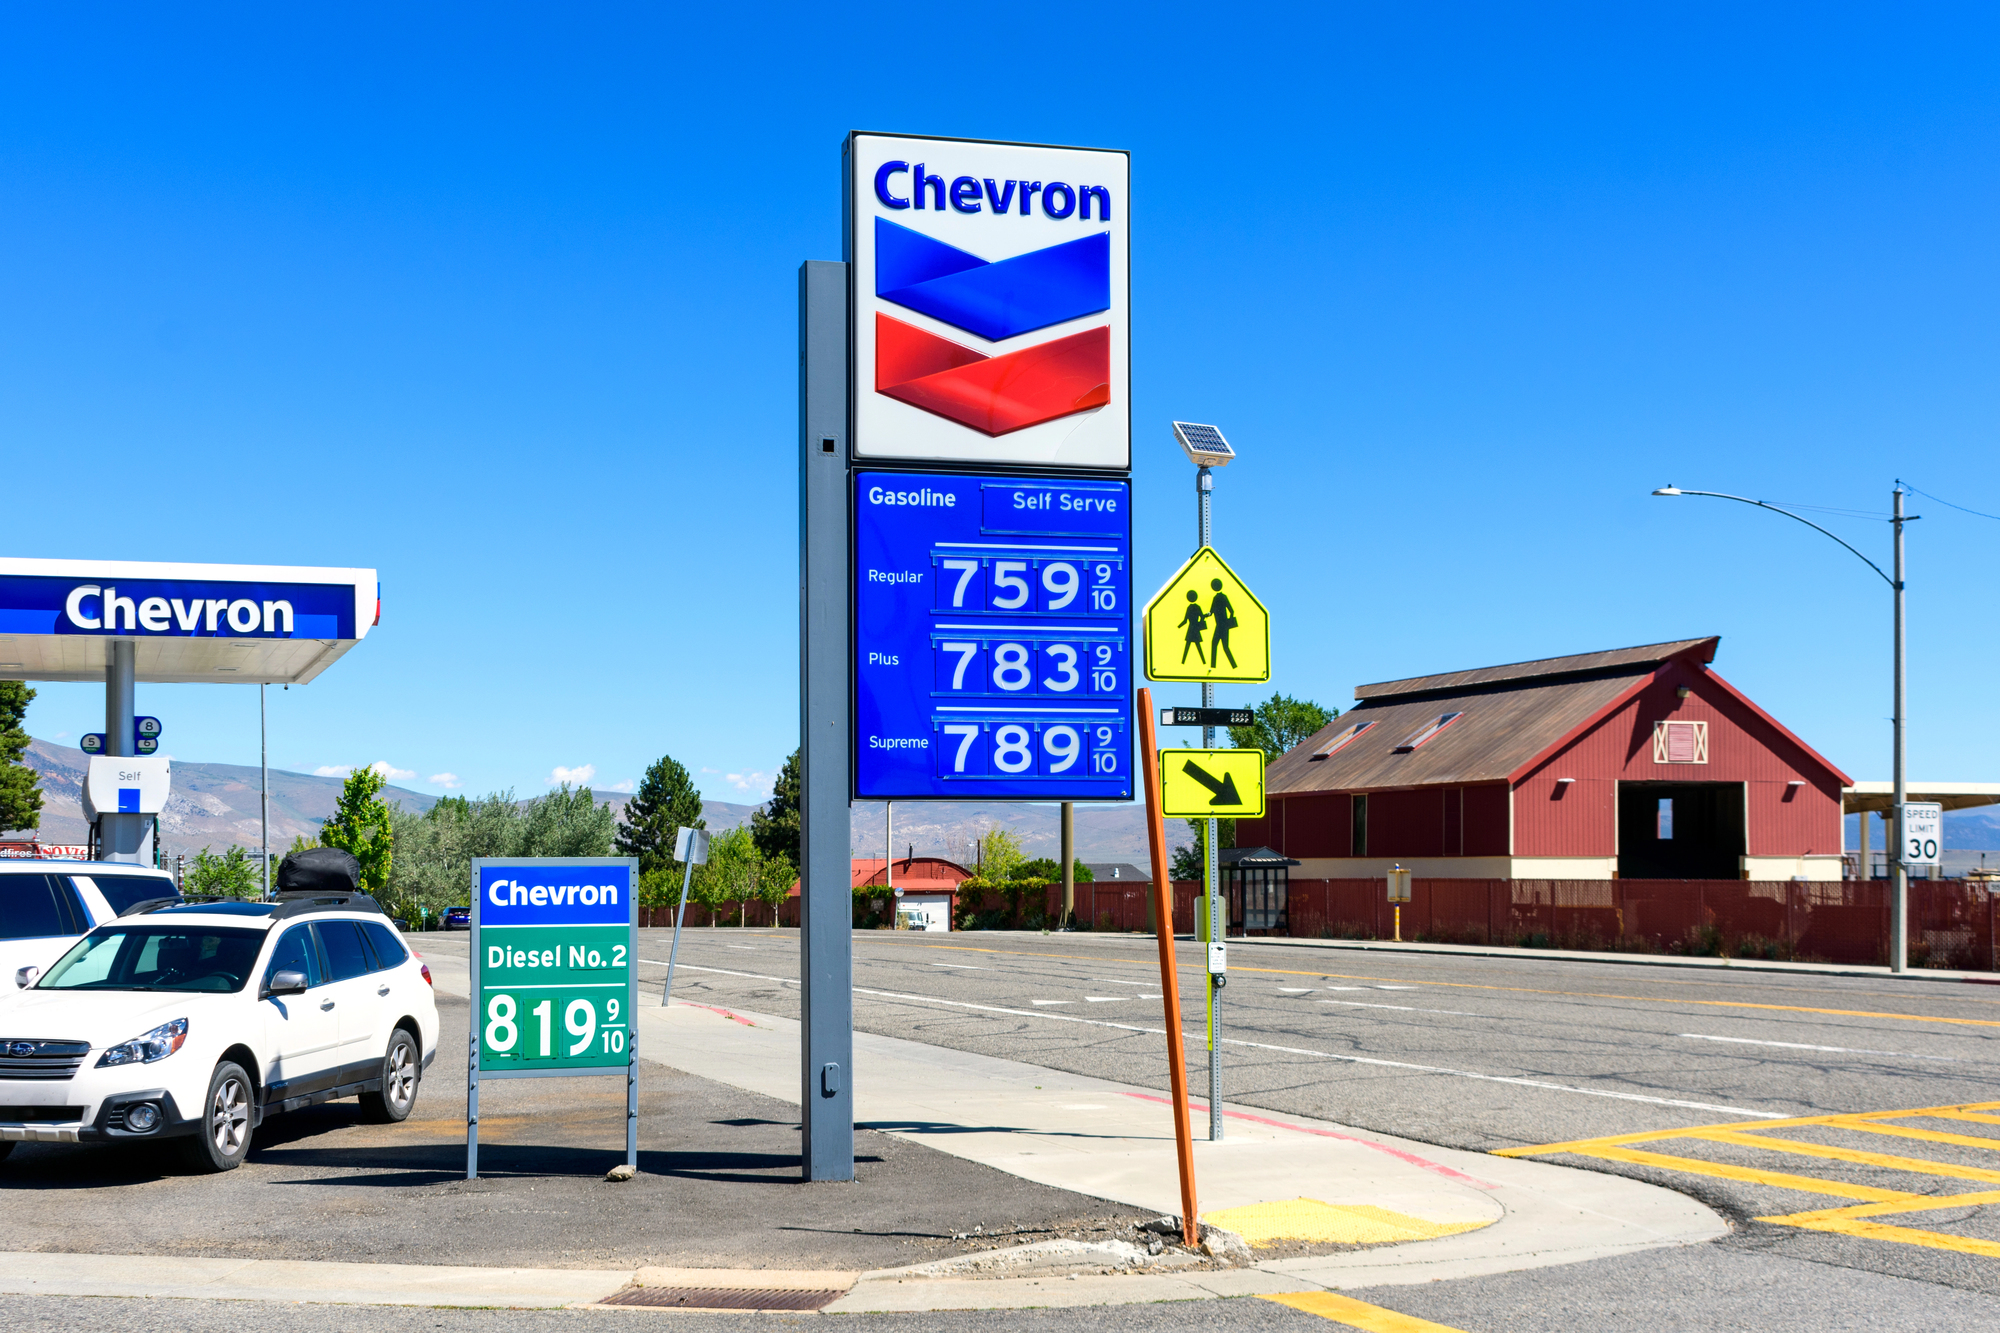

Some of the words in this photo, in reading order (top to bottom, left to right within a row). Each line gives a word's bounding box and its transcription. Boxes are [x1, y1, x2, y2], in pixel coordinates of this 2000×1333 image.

[874, 160, 1111, 221] Chevron
[868, 486, 956, 507] Gasoline
[1013, 491, 1052, 510] Self
[1060, 494, 1117, 513] Serve
[868, 570, 923, 585] Regular
[943, 560, 1080, 610] 759
[66, 584, 294, 633] Chevron
[869, 652, 899, 666] Plus
[942, 642, 1080, 692] 783
[145, 721, 153, 731] 8
[88, 738, 95, 746] 5
[869, 736, 929, 751] Supreme
[944, 724, 1081, 774] 789
[119, 771, 141, 781] Self
[1906, 809, 1938, 819] SPEED
[1909, 824, 1935, 833] LIMIT
[43, 847, 63, 858] NO
[1909, 838, 1937, 859] 30
[488, 879, 618, 906] Chevron
[488, 944, 561, 968] Diesel
[569, 945, 607, 968] No.
[612, 944, 627, 967] 2
[485, 994, 597, 1057] 819
